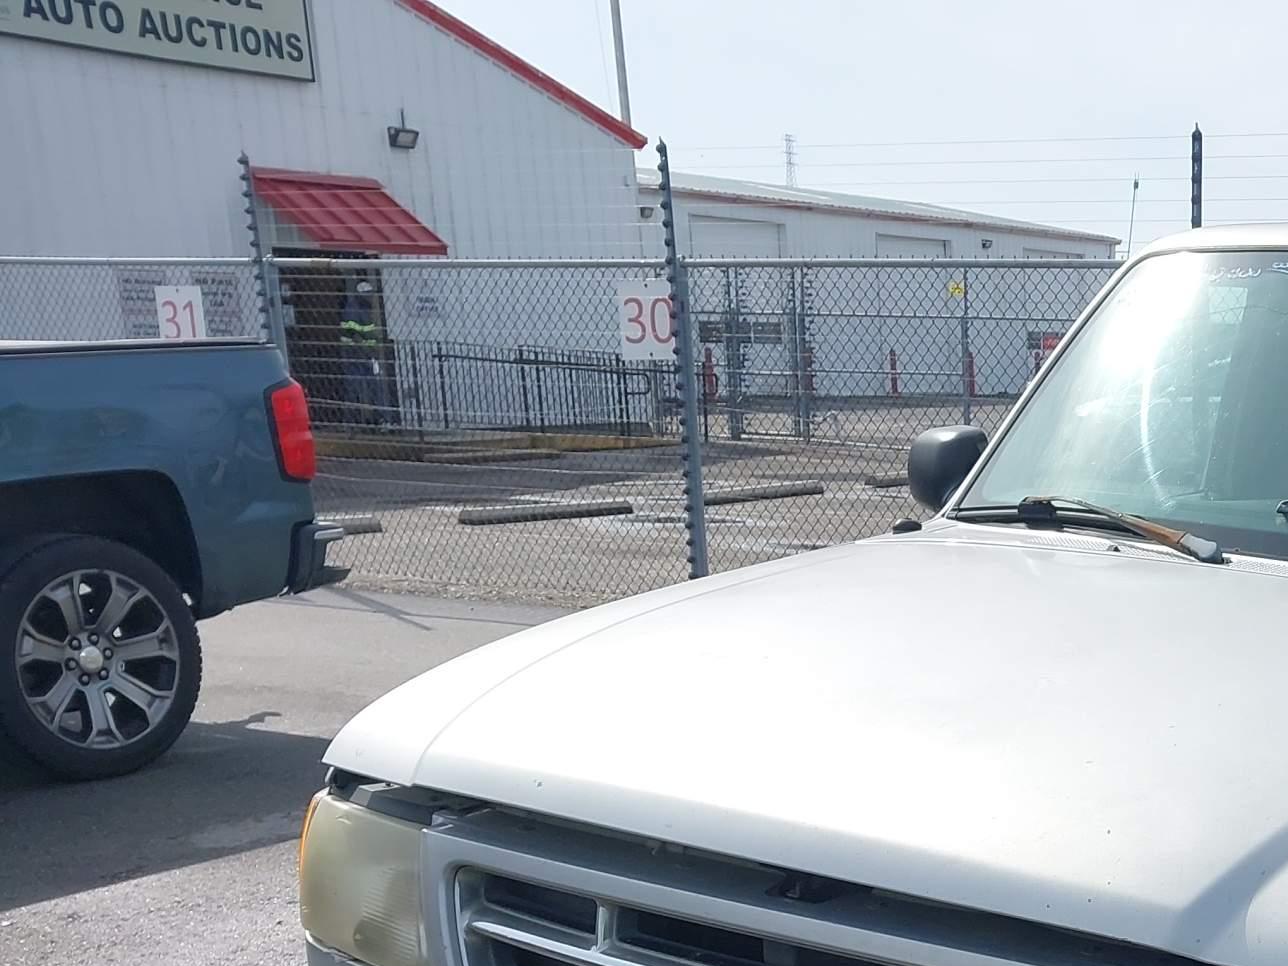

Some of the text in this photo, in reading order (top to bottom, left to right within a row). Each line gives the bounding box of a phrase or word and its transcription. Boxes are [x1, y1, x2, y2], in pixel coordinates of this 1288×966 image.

[23, 0, 304, 62] AUTO AUCTIONS
[161, 299, 197, 338] 31
[624, 297, 674, 344] 30
